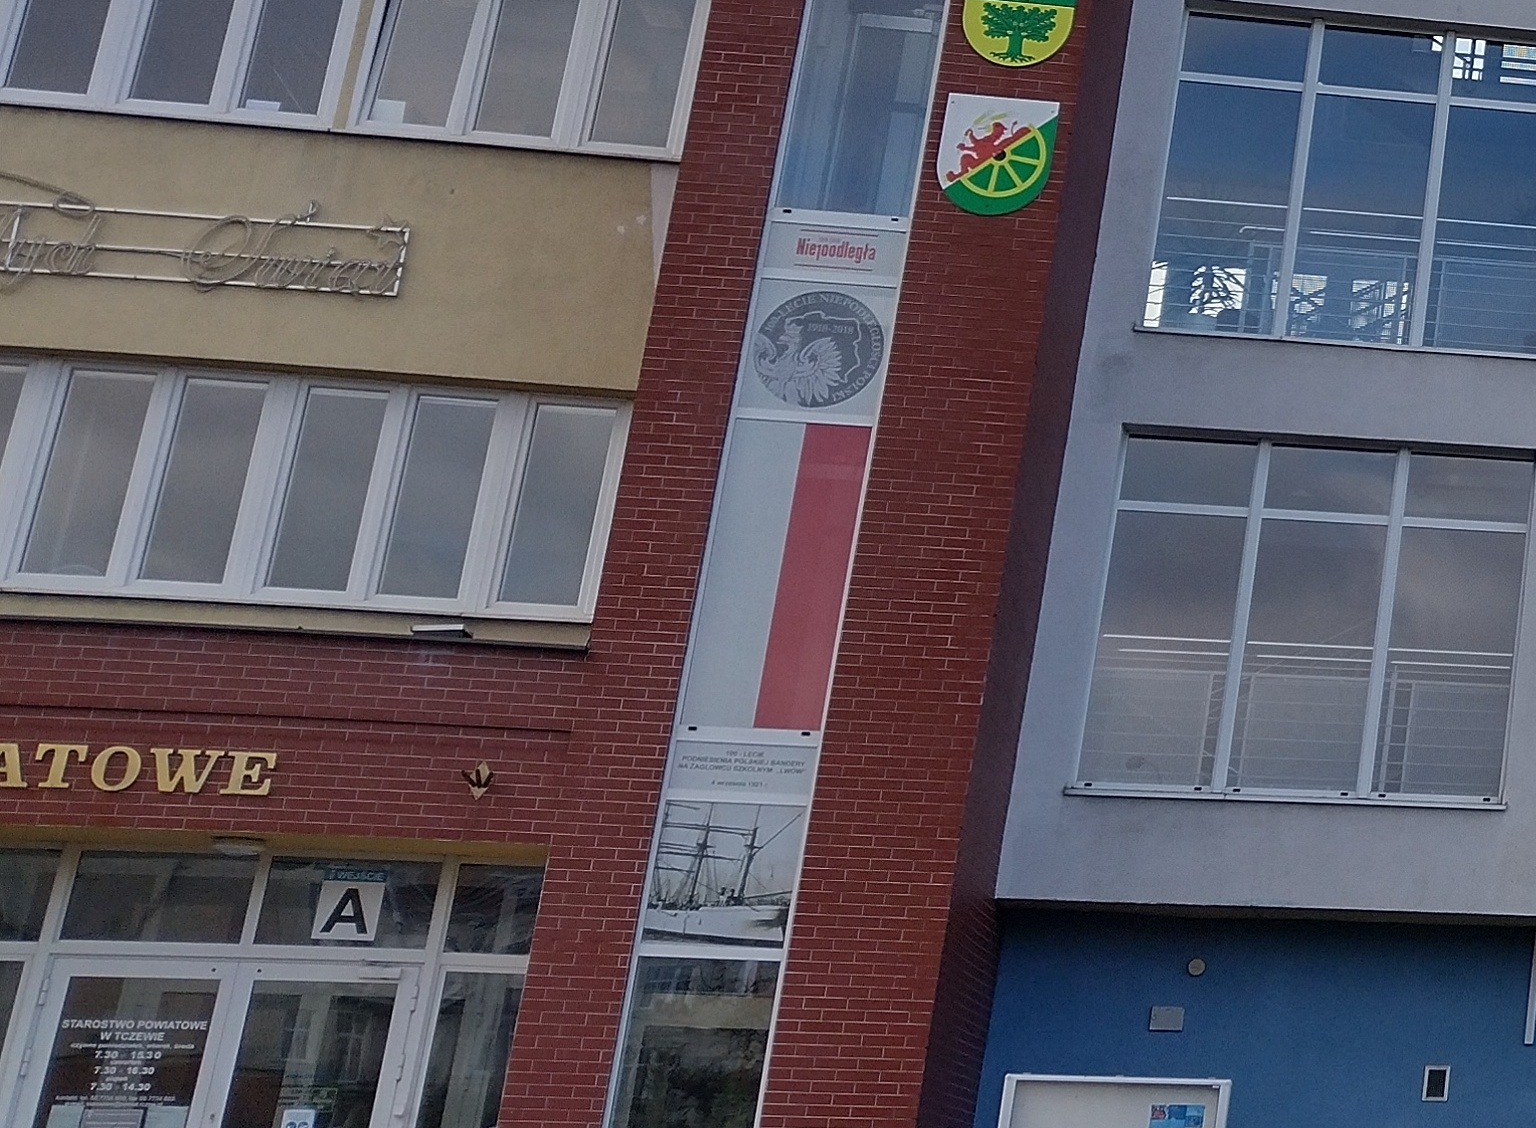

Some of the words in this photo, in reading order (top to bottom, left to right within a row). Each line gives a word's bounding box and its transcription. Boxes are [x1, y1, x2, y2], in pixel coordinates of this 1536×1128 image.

[796, 236, 877, 264] Niepodległa
[806, 322, 855, 335] 1918-2018
[319, 887, 368, 935] A
[61, 1019, 136, 1030] STAROSTWO
[136, 1020, 208, 1031] POWIATOWE
[100, 1031, 114, 1041] W
[114, 1032, 166, 1042] TCZEWIE
